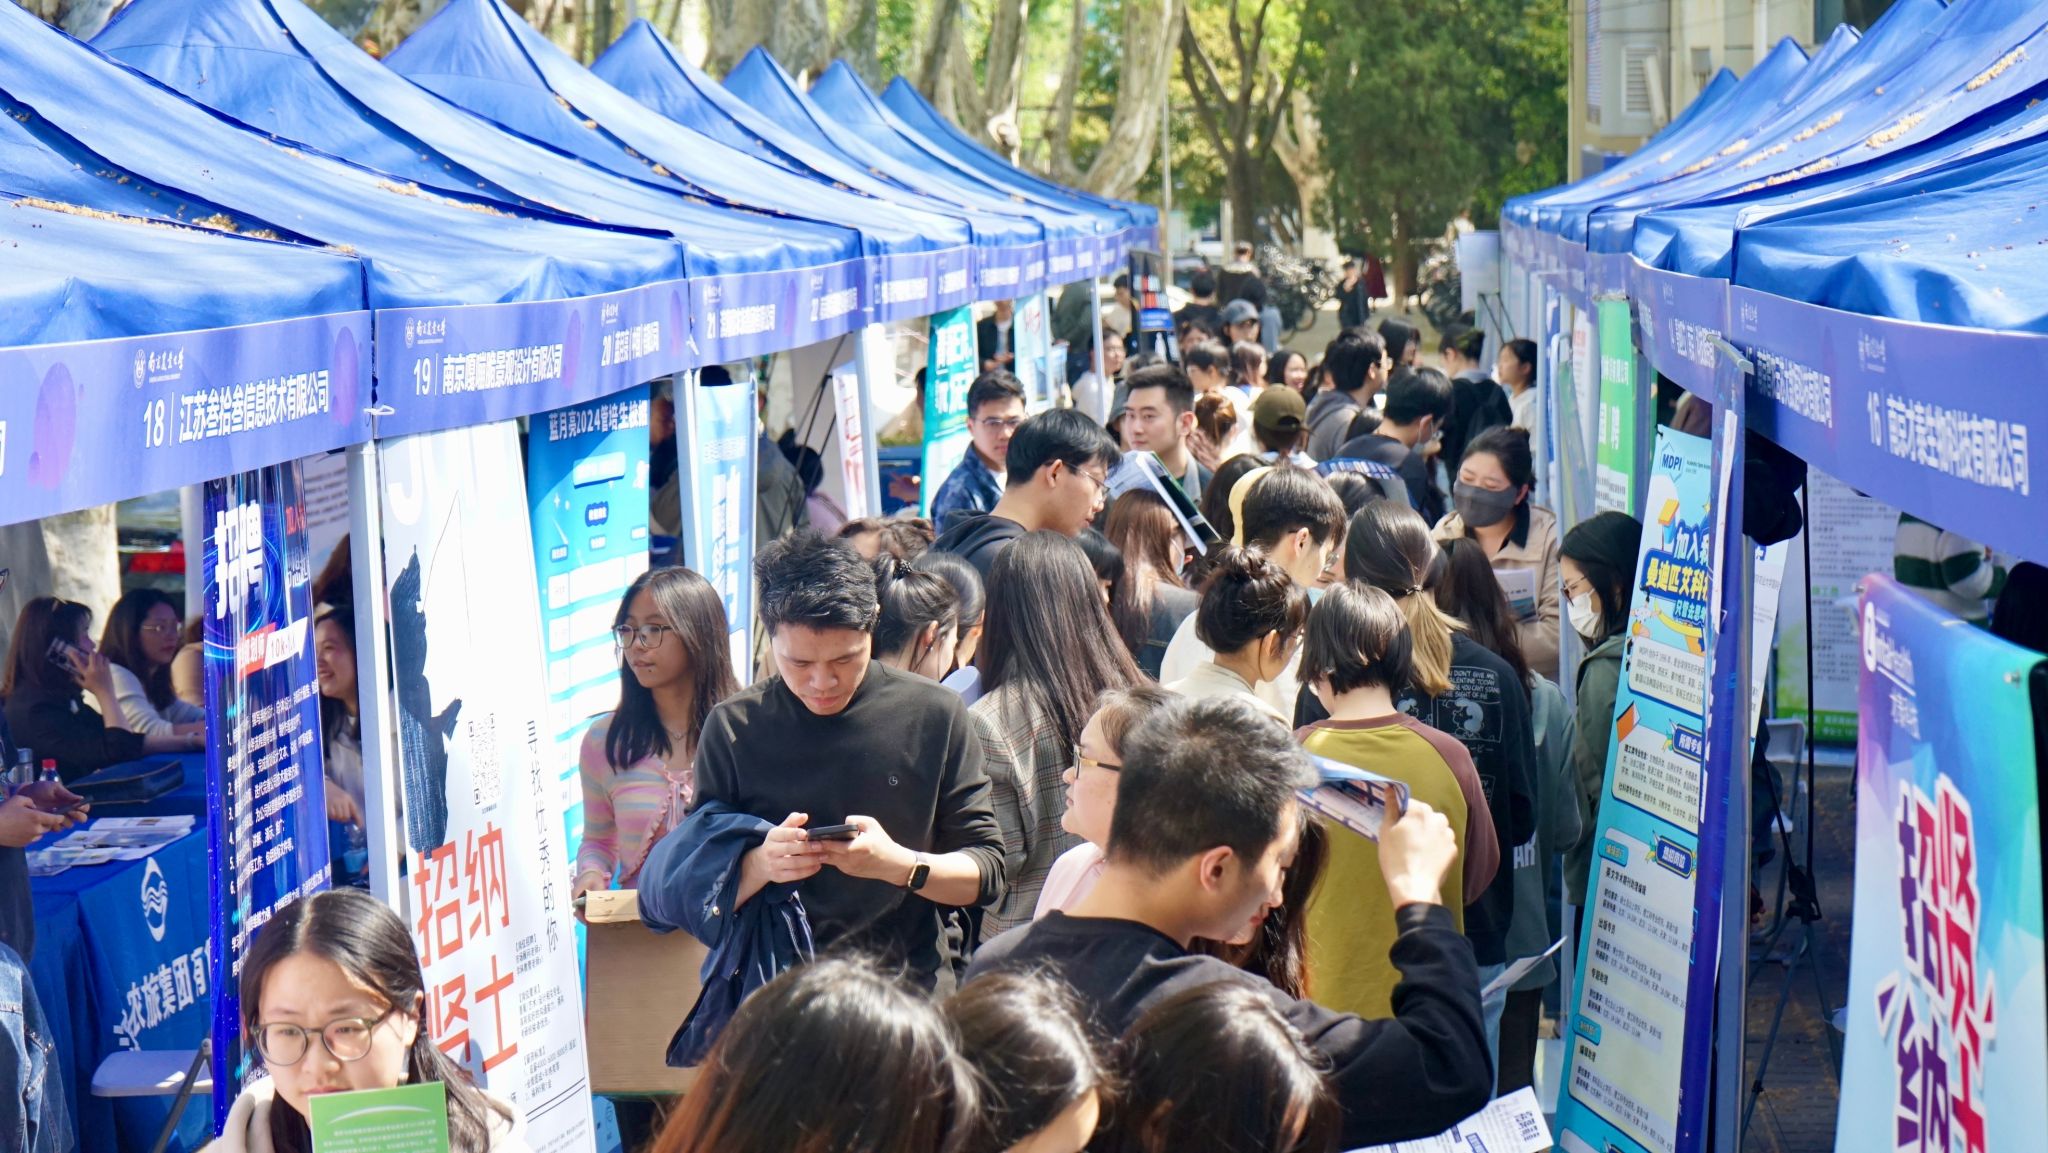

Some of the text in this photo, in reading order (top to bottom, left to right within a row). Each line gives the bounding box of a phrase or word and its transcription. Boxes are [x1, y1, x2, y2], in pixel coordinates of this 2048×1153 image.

[144, 369, 330, 449] 18 江苏叁拾叁信息技术有限公司
[414, 357, 431, 396] 19
[1867, 391, 1882, 447] 16
[1662, 453, 1683, 472] MDPI
[214, 499, 263, 621] 招聘
[1472, 671, 1485, 679] GIVE
[526, 720, 560, 954] 寻找优秀的你
[413, 821, 510, 968] 招纳
